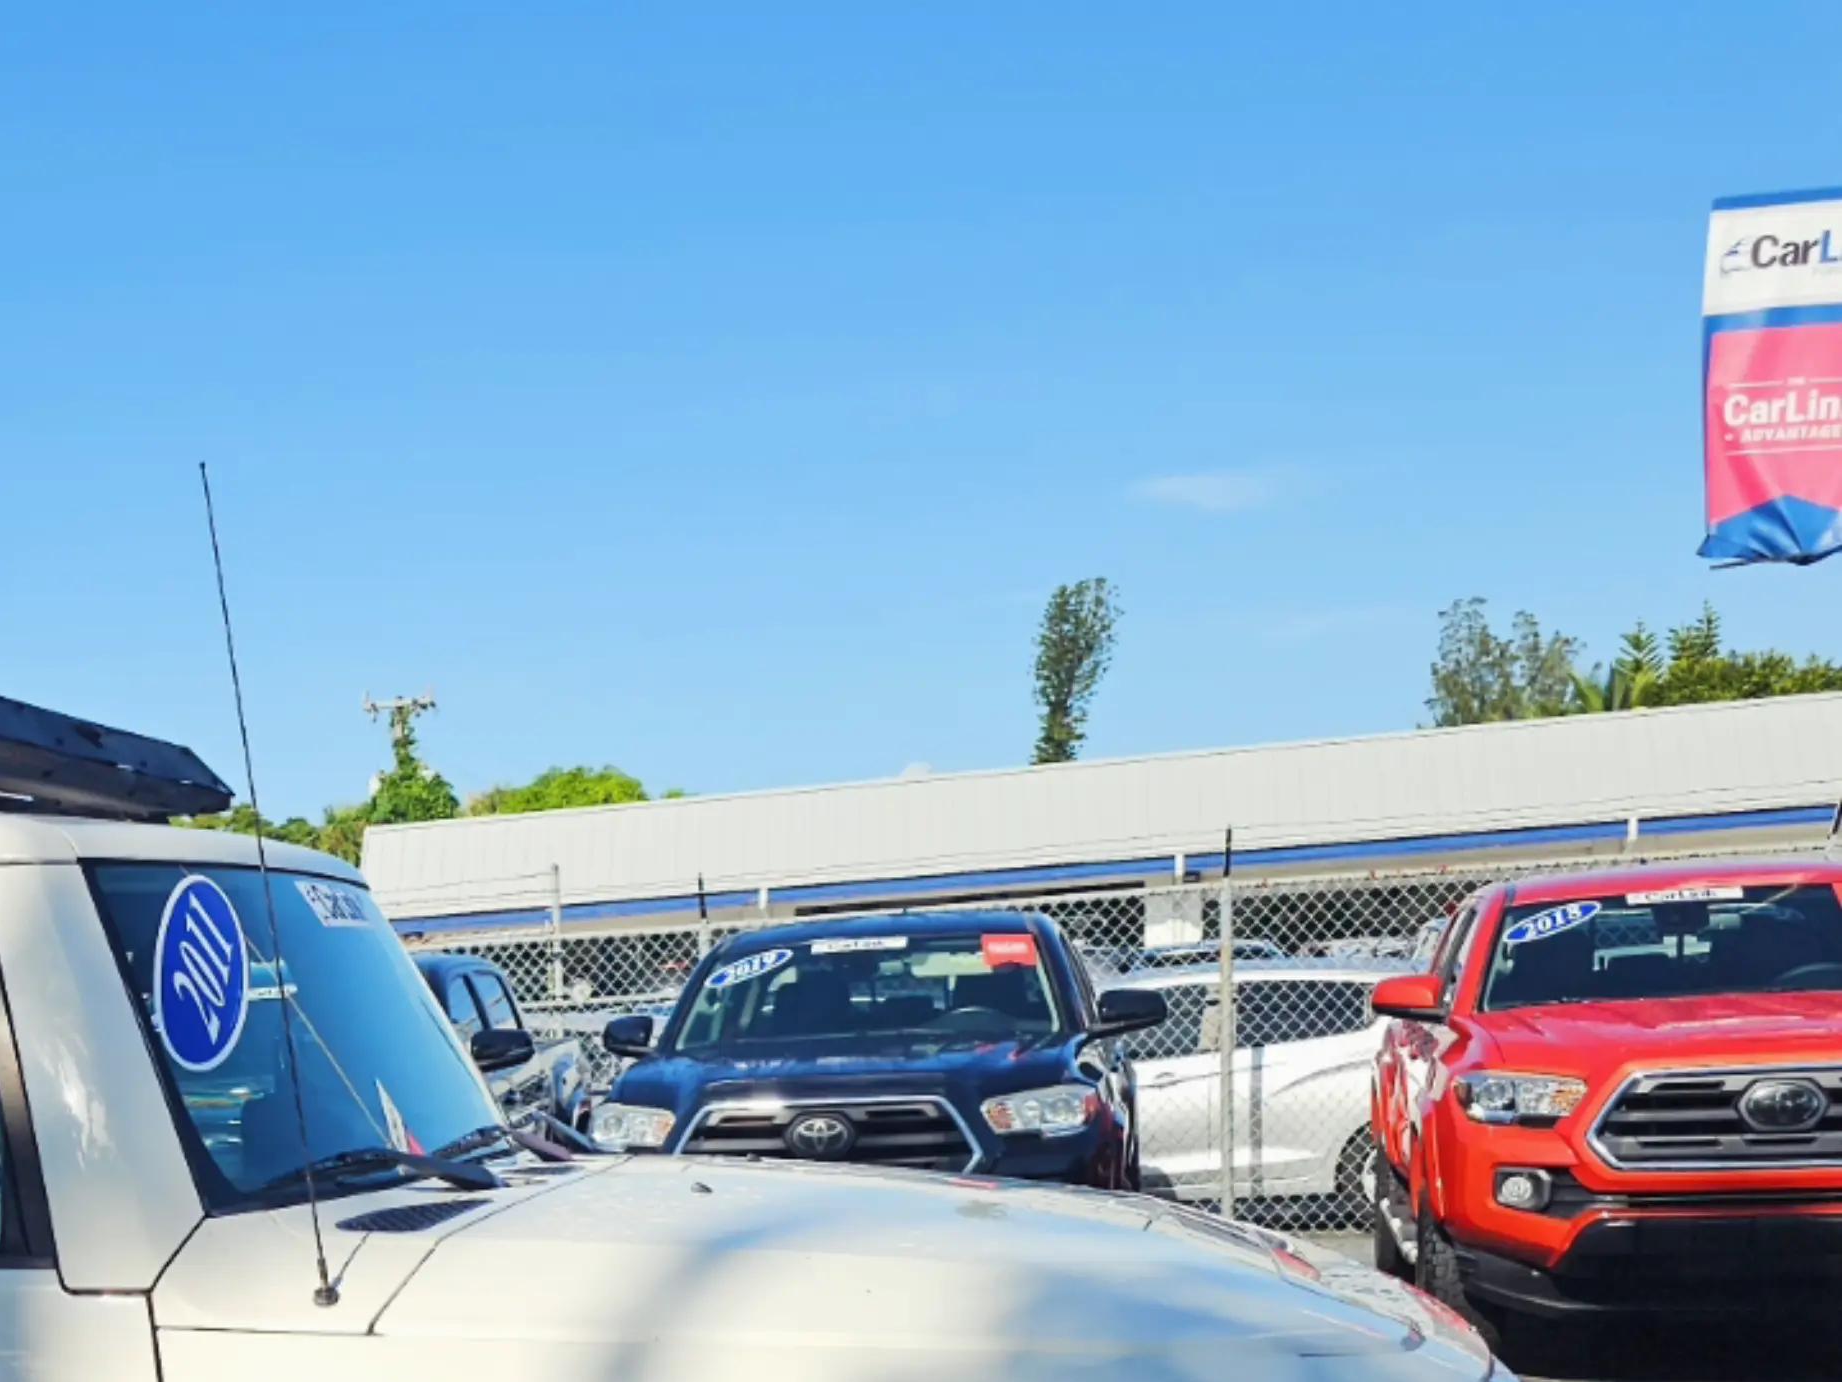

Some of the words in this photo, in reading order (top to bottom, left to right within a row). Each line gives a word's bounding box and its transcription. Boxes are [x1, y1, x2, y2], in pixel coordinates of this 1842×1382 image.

[1751, 230, 1842, 269] CarL
[1724, 389, 1842, 427] CarLin
[1525, 903, 1581, 940] 2018
[173, 891, 233, 1045] 2011
